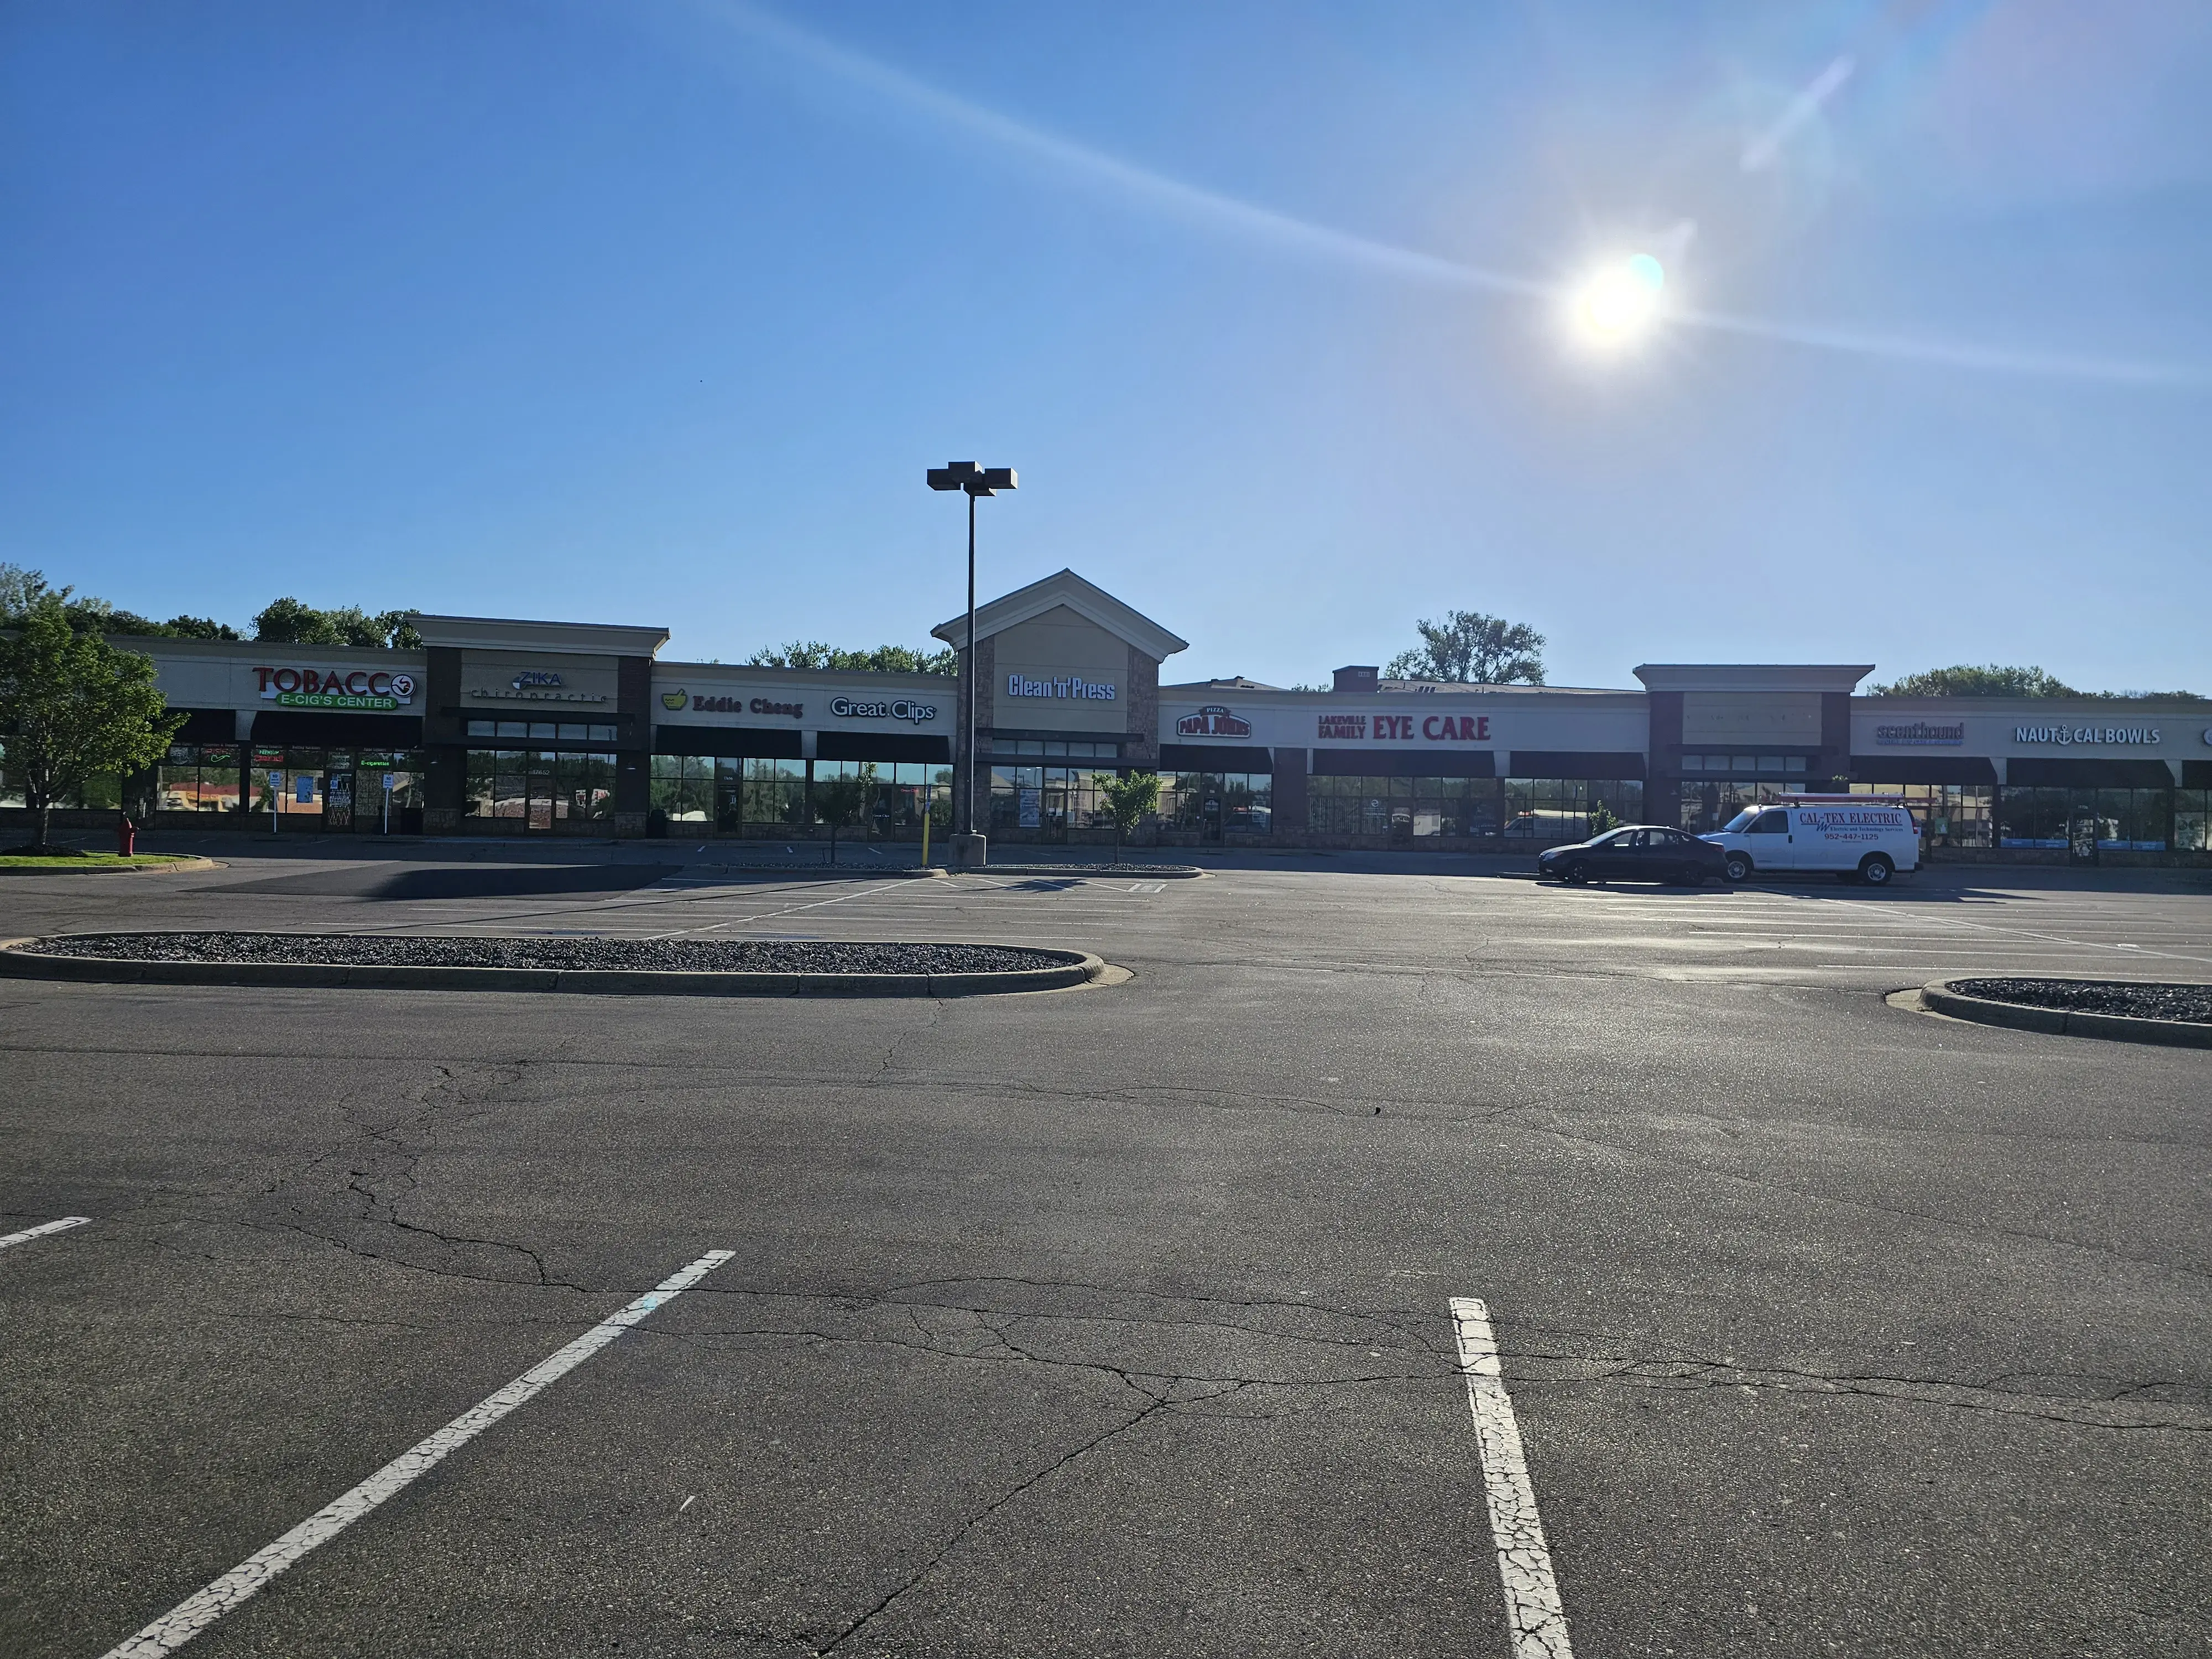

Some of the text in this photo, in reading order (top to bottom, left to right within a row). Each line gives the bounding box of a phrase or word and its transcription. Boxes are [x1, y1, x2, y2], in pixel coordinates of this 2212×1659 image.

[520, 671, 562, 685] ZIKA
[280, 694, 393, 709] E-CIG'S CENTER
[470, 687, 608, 702] chiropractic
[692, 696, 804, 718] Eddie Cheng
[831, 697, 936, 725] Great Clips
[1180, 716, 1209, 734] PAPA
[1318, 715, 1366, 725] LAKEVILLE
[1318, 725, 1365, 739] FAMILY
[1373, 716, 1491, 740] EYE CARE
[1877, 722, 1964, 739] scenthound
[2105, 728, 2161, 744] BOWLS
[1800, 812, 1902, 824] CAL-TEX ELECTRIC
